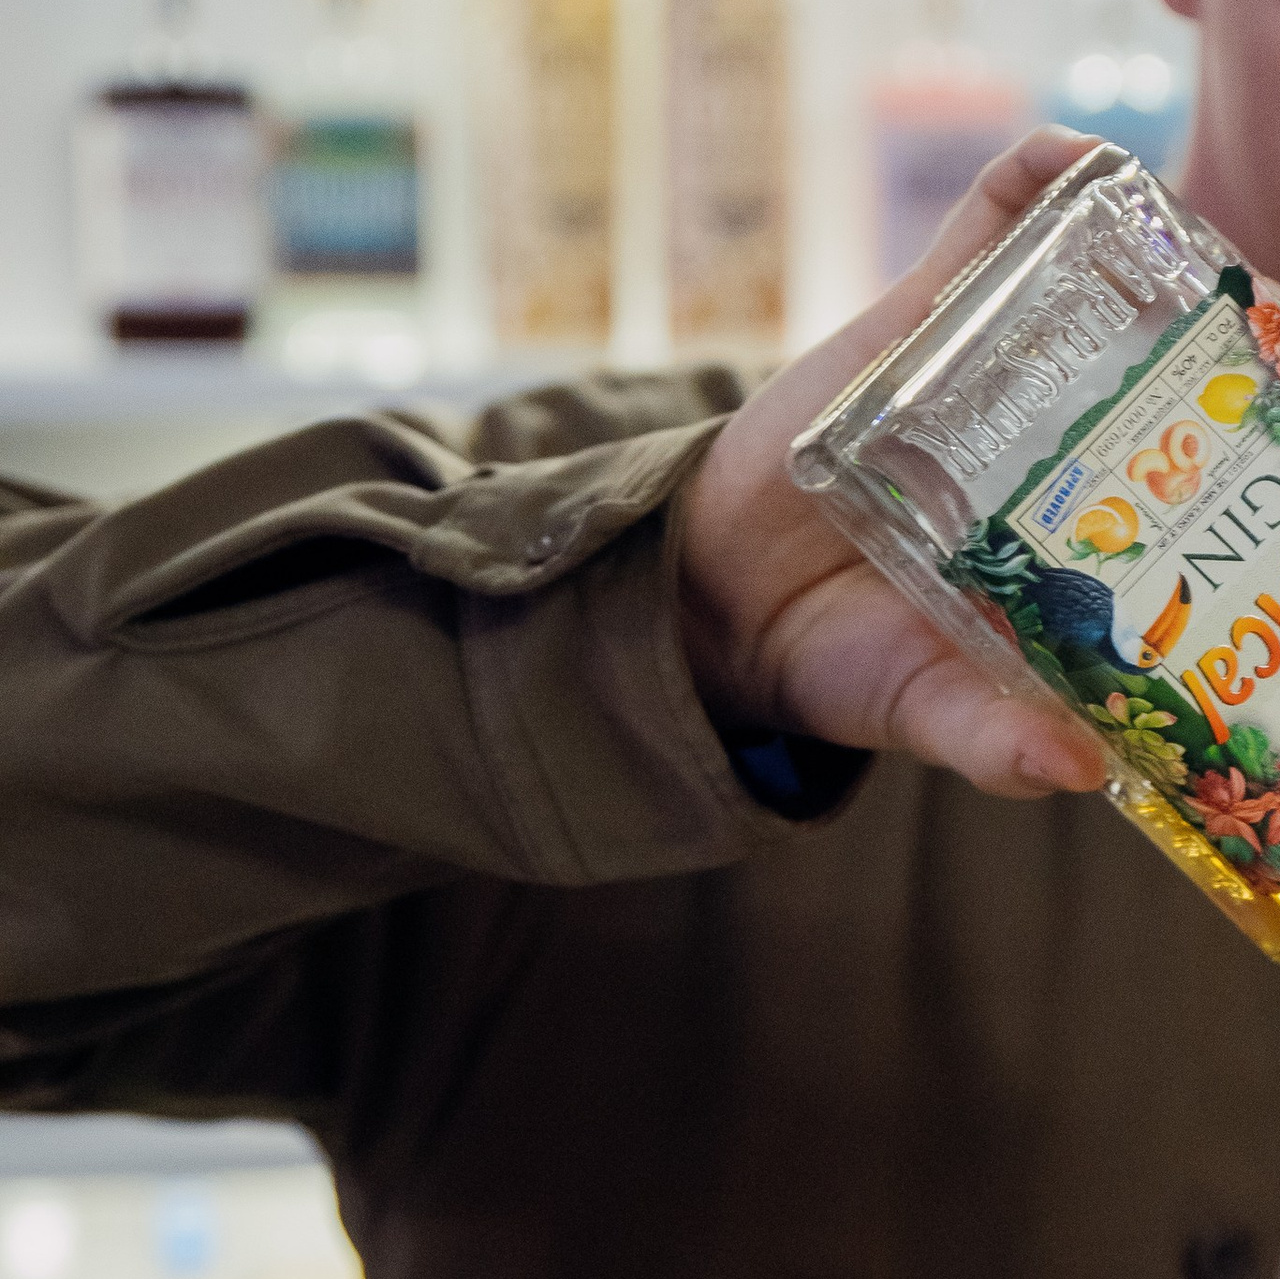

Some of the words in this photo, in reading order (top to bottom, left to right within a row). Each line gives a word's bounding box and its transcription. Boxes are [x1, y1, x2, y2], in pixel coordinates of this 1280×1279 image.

[902, 209, 1189, 480] BARRISTER
[1168, 351, 1199, 381] 40%
[1093, 403, 1149, 459] 0007699
[1038, 465, 1084, 525] APPROVED
